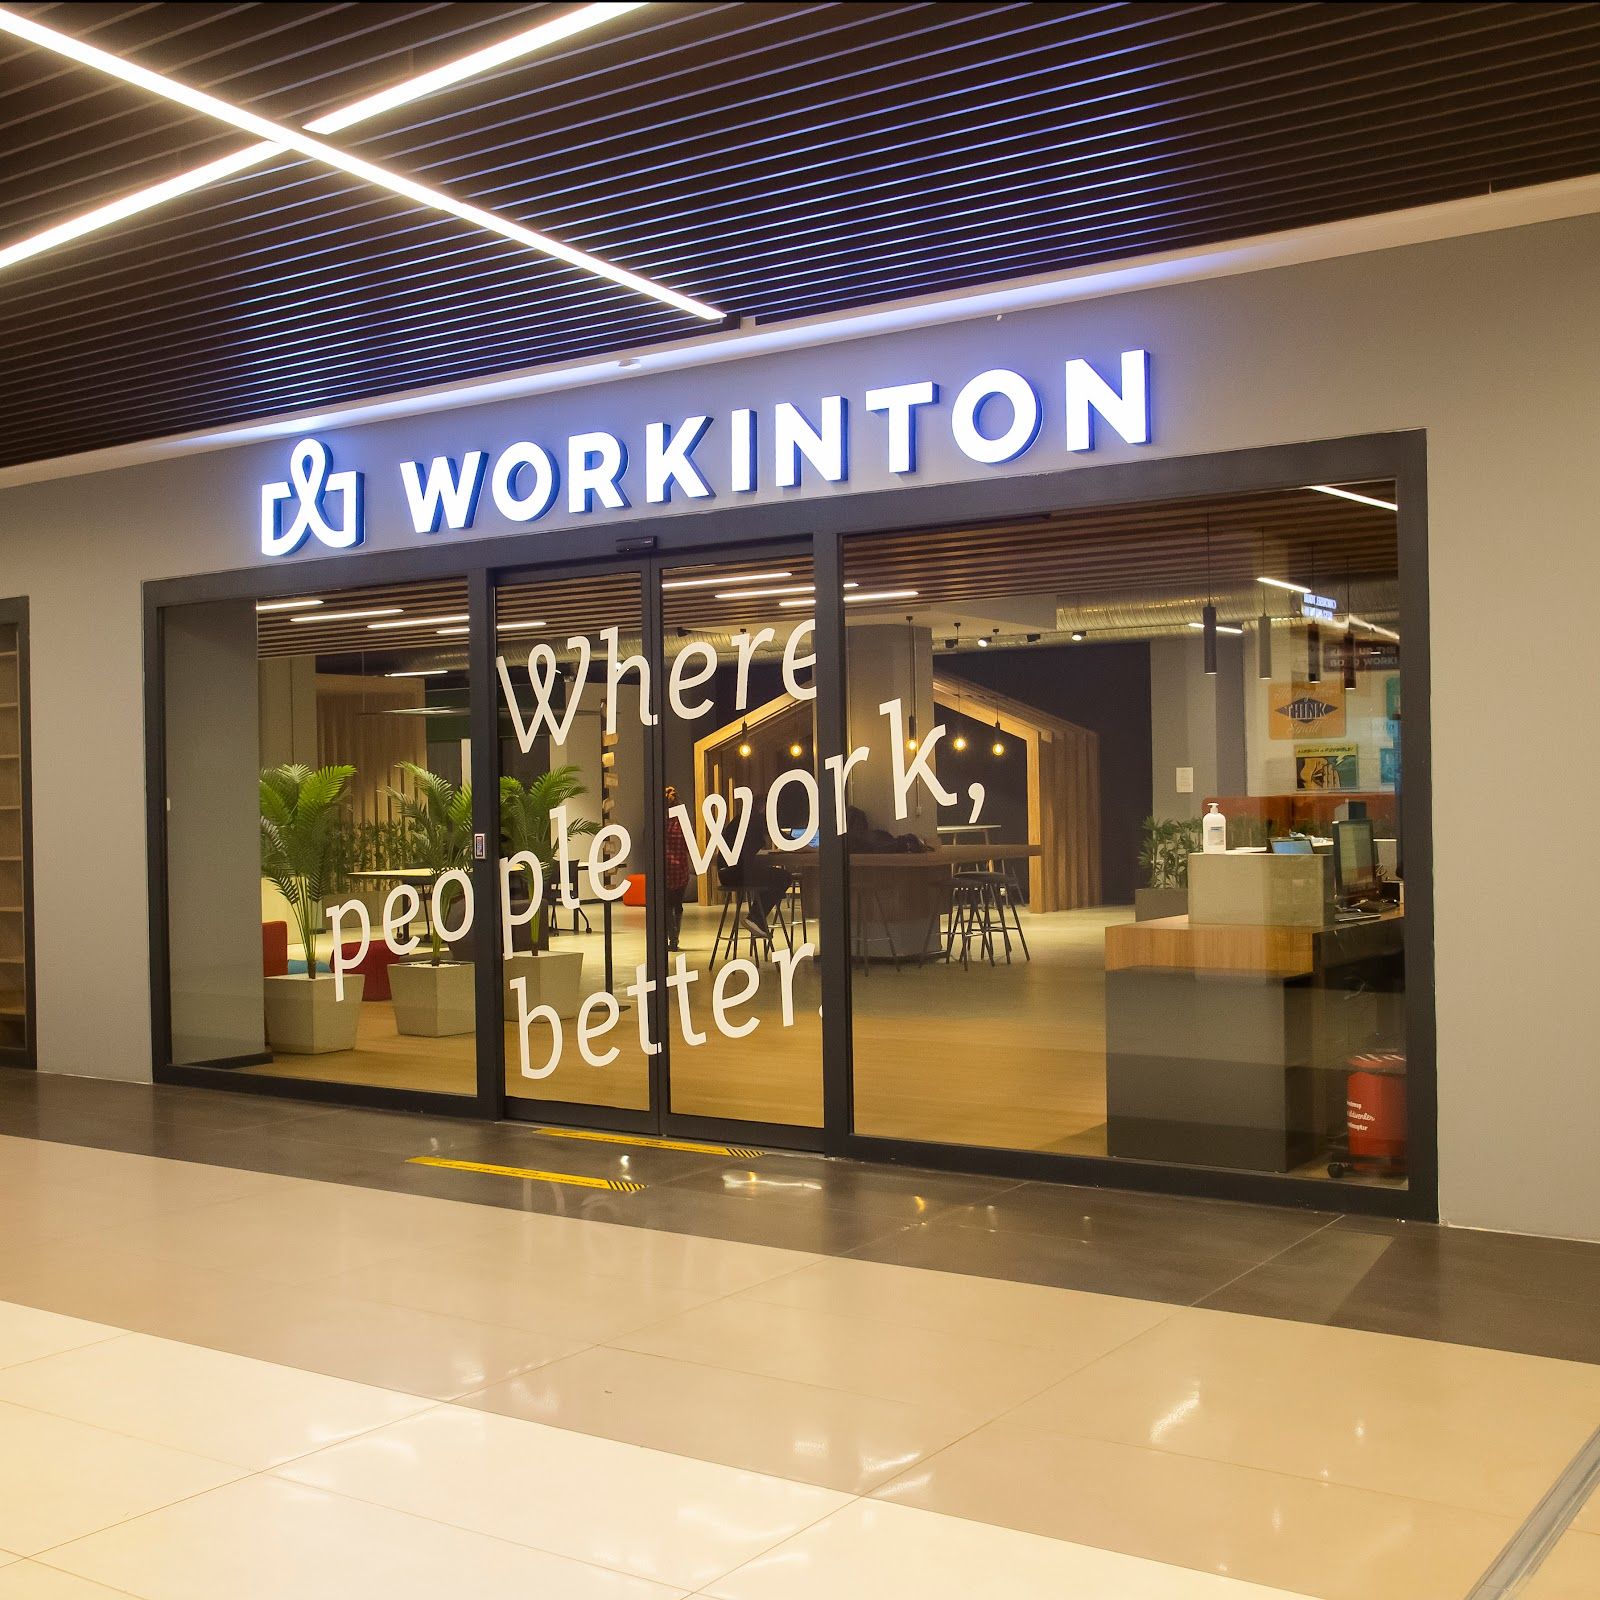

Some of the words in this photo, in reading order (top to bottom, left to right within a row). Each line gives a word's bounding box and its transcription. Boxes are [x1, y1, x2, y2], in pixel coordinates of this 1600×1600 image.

[400, 349, 1152, 535] WORKINTON
[496, 618, 817, 755] Where
[1284, 702, 1328, 720] THINK
[326, 804, 632, 1002] people
[669, 699, 986, 877] work,
[509, 942, 823, 1079] better
